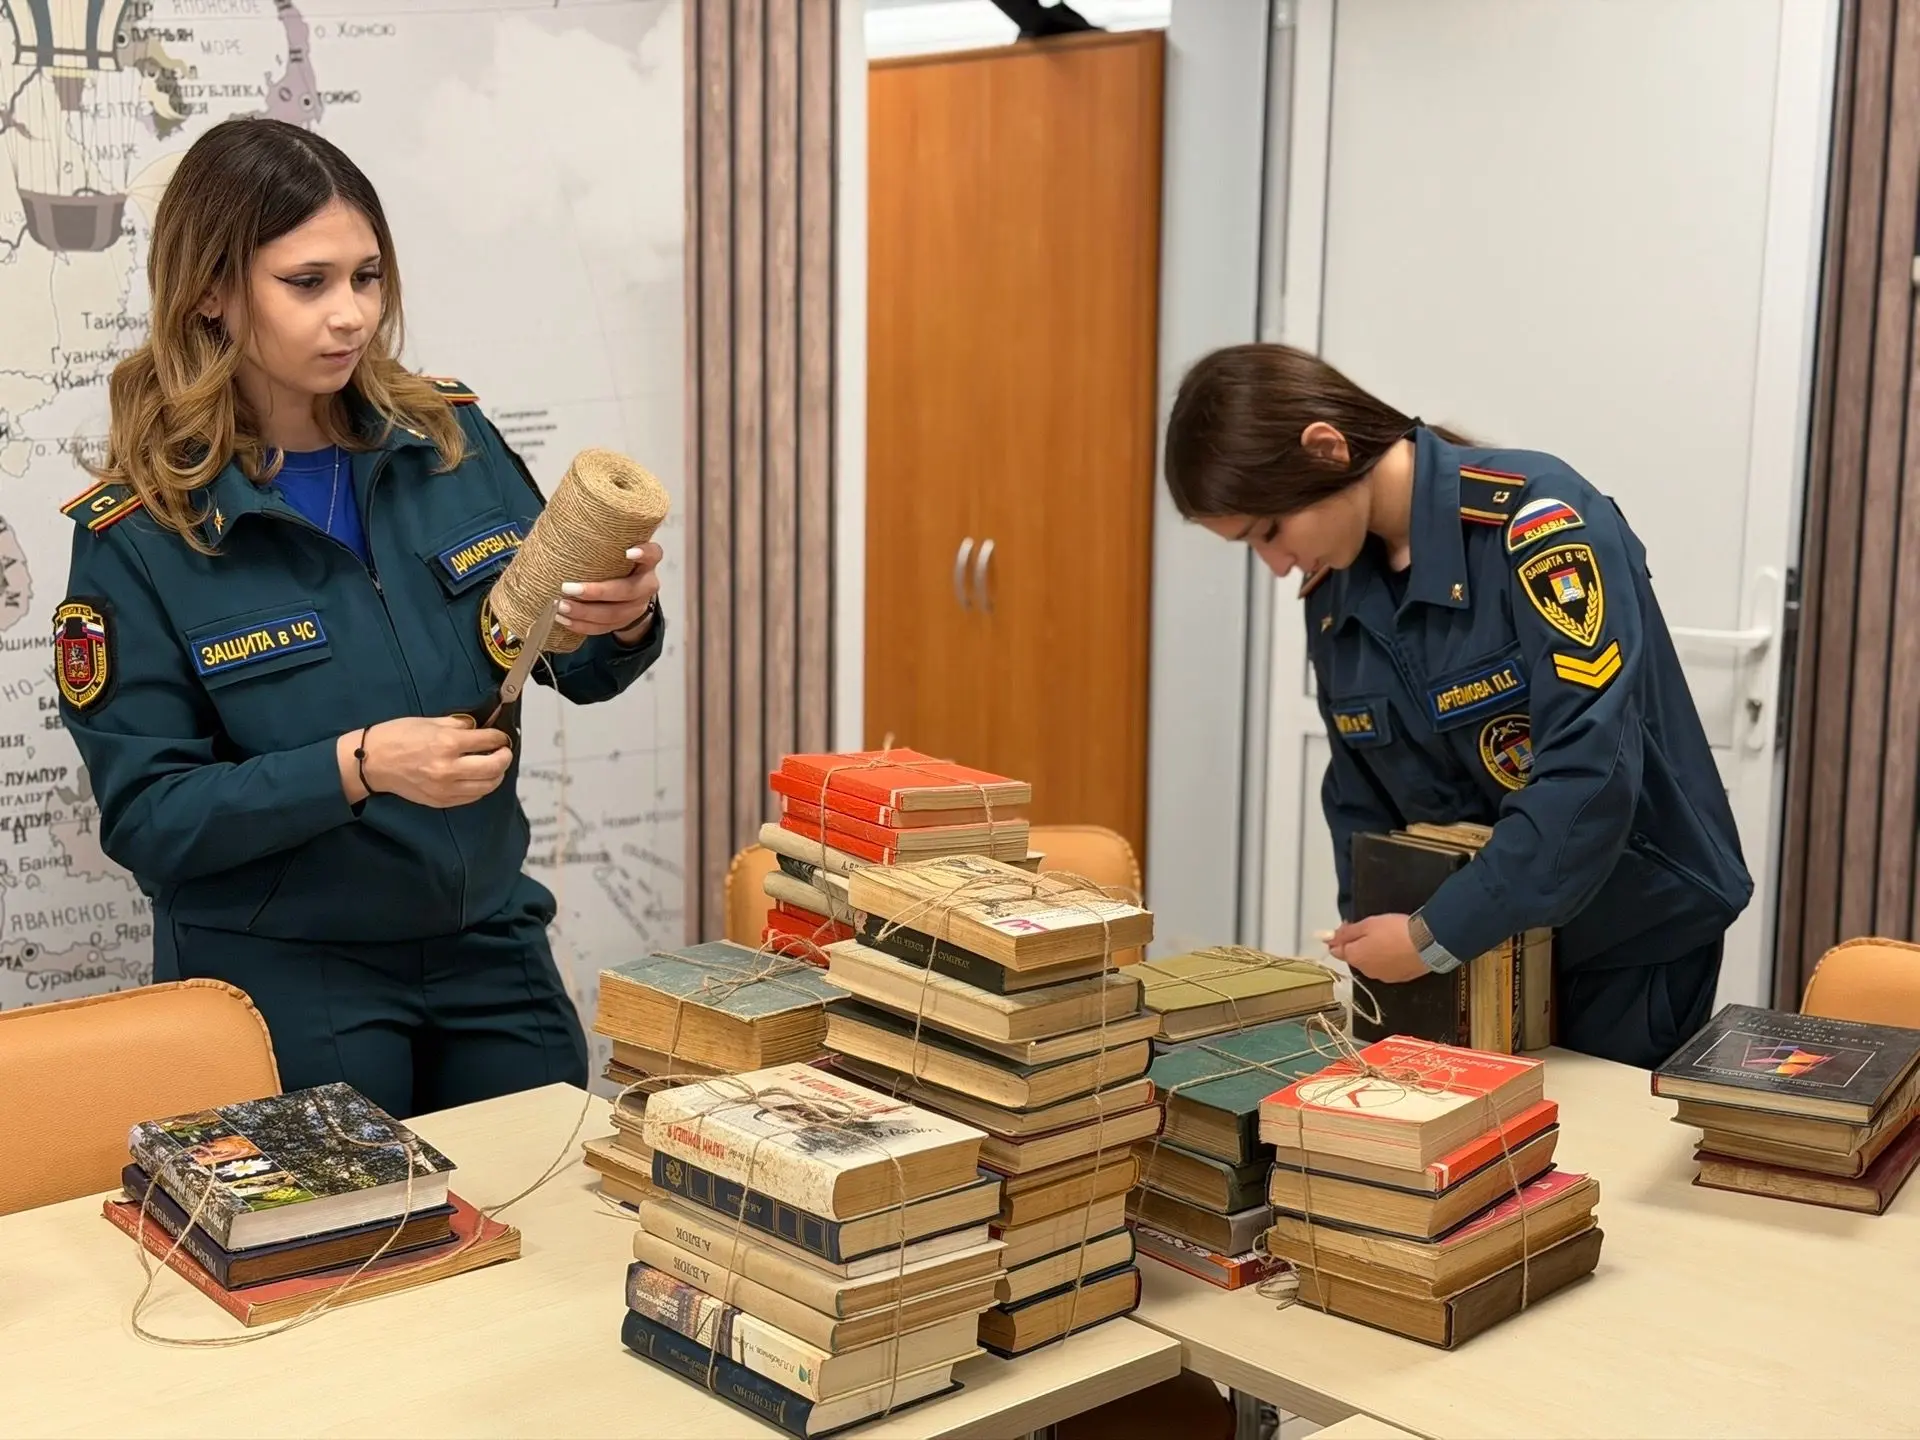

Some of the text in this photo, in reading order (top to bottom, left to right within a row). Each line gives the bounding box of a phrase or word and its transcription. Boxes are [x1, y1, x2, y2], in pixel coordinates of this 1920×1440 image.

[1523, 518, 1569, 541] RUSSIA
[1525, 554, 1564, 580] ЗАЩИТА
[1576, 549, 1588, 562] ЧС
[201, 630, 275, 666] ЗАЩИТА
[291, 621, 317, 641] ЧС
[1437, 679, 1493, 713] АРТЁМОВА
[19, 854, 73, 873] Банка
[10, 902, 118, 933] ЯВАНСКОЕ
[26, 964, 106, 992] Сурабая
